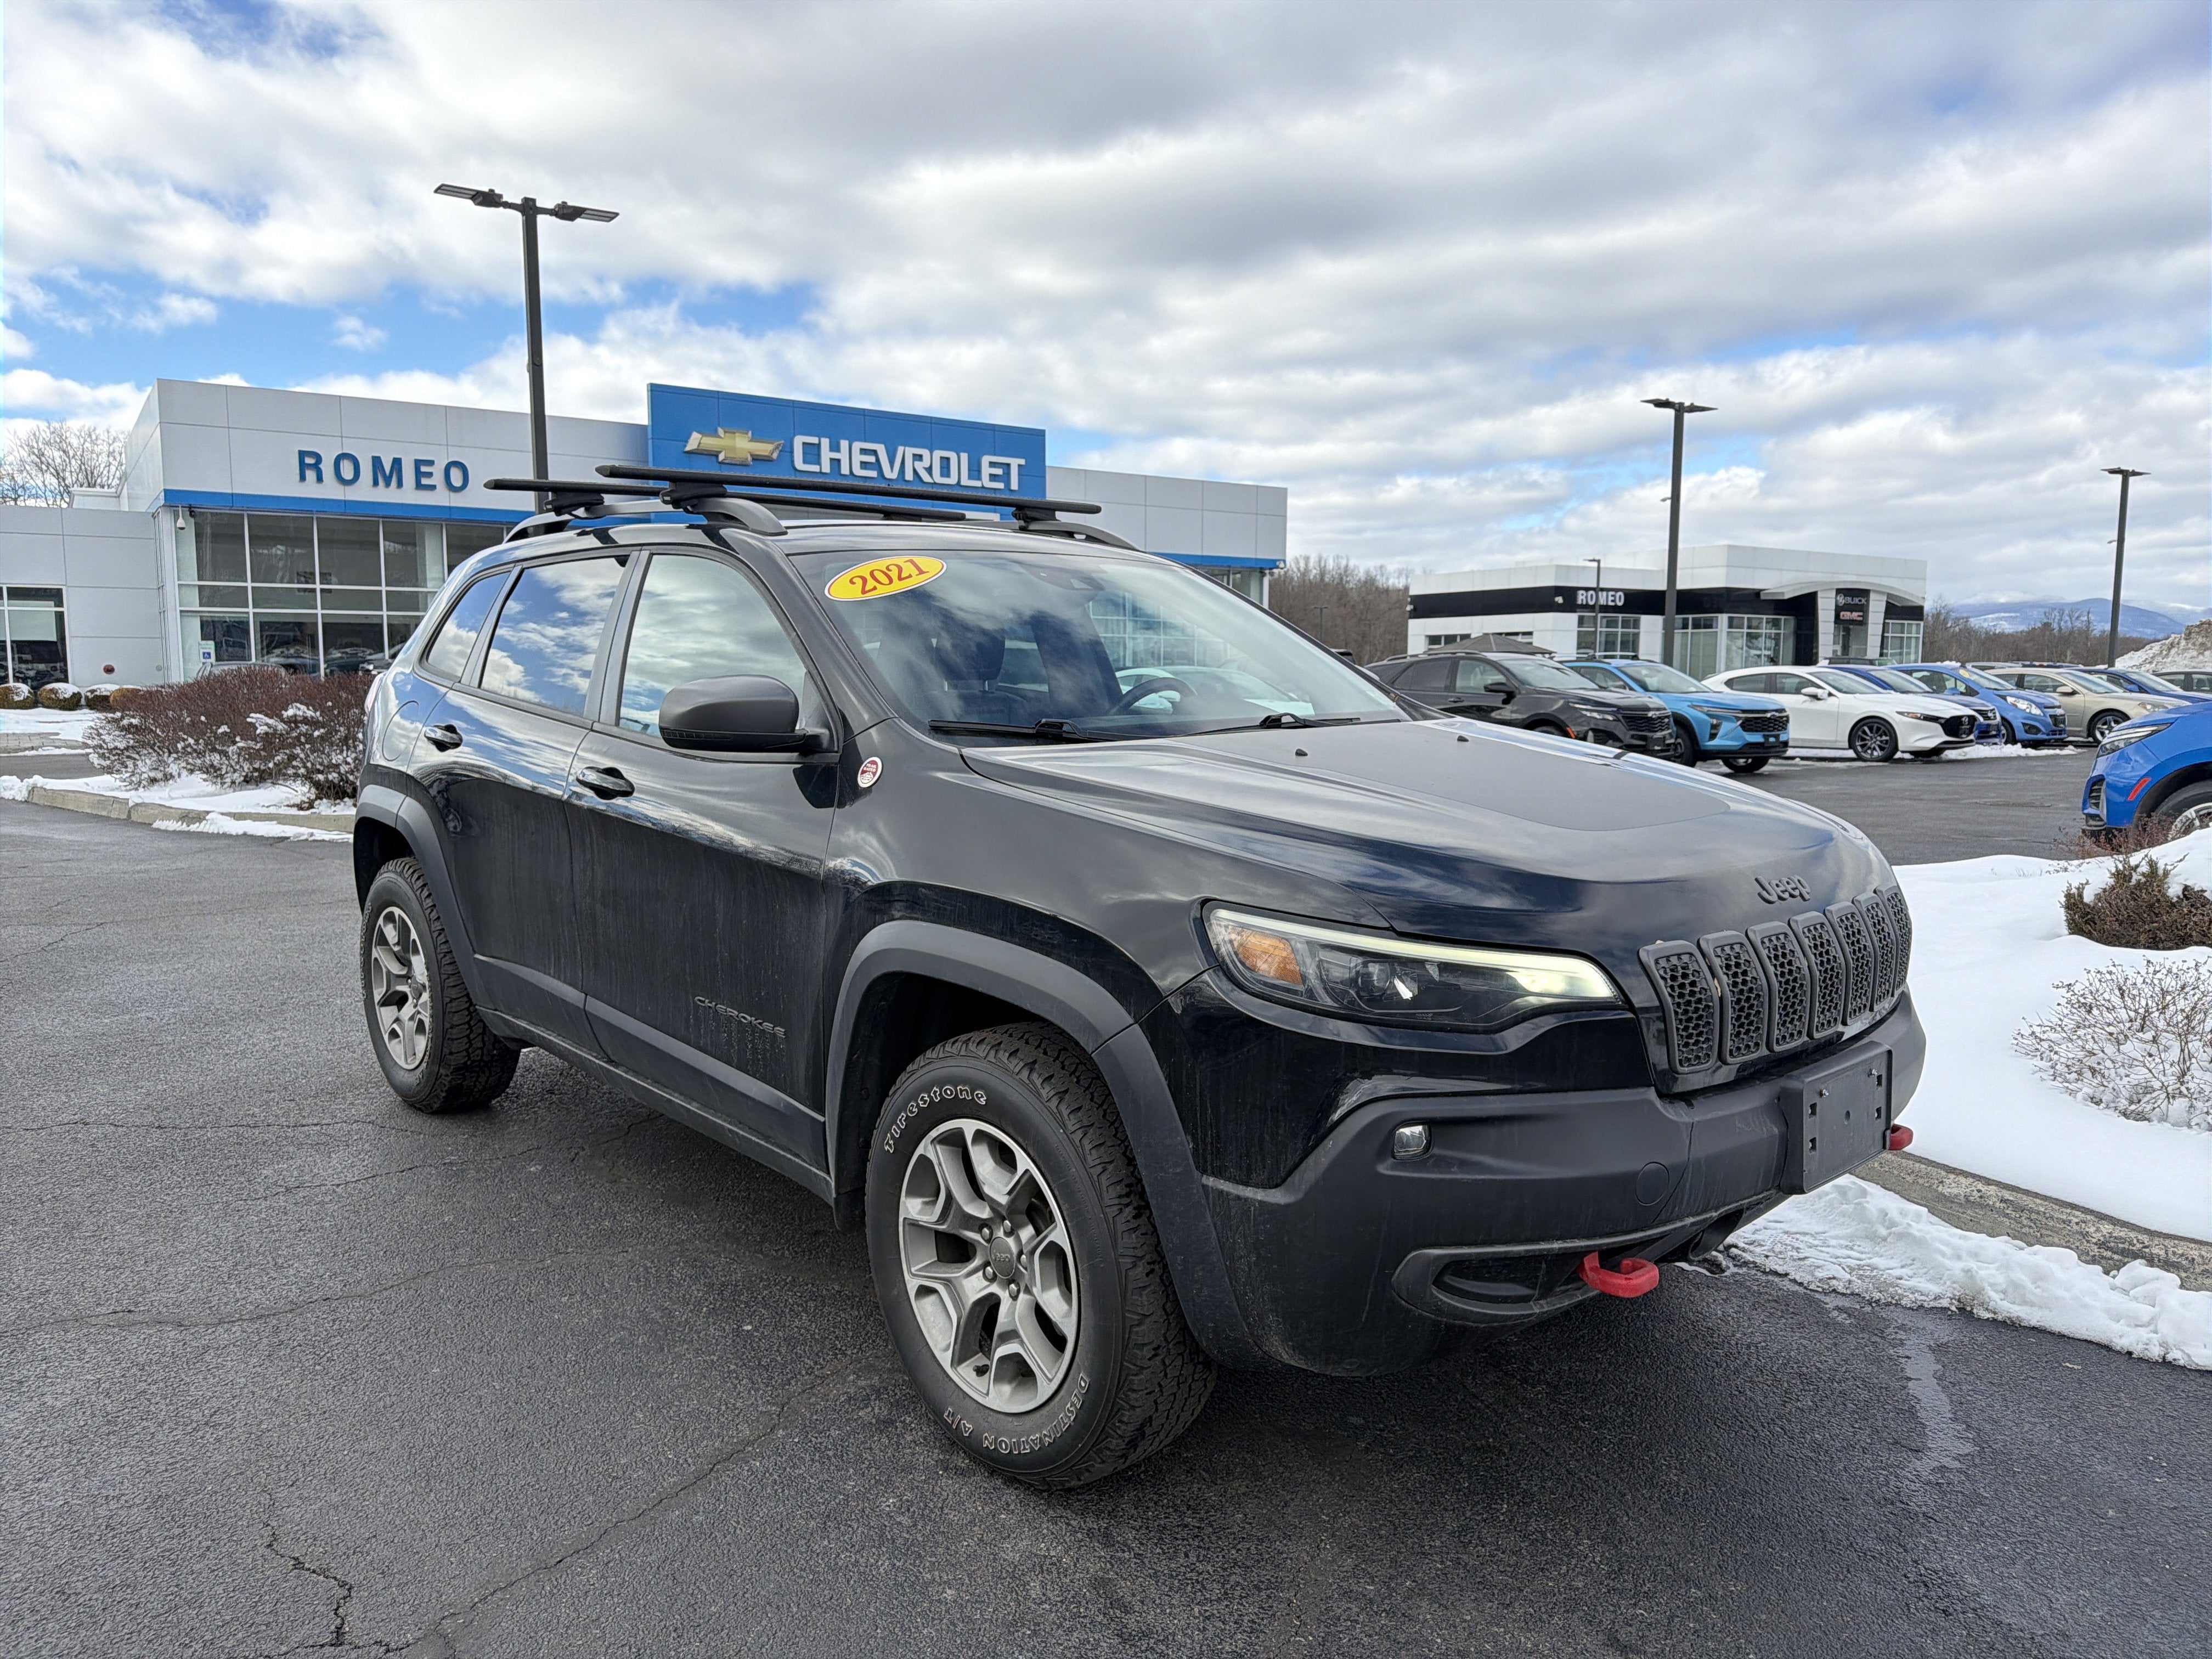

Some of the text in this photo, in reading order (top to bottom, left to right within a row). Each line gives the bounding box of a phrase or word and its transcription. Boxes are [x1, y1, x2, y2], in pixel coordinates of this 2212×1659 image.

[298, 450, 470, 493] ROMEO
[793, 435, 1025, 490] CHEVROLET
[849, 558, 930, 595] 2021
[1577, 590, 1624, 606] ROMEO
[1839, 611, 1863, 620] GMC
[1844, 596, 1867, 605] BUICK
[1754, 875, 1811, 904] Jeep
[694, 996, 786, 1038] CHEROKEE
[884, 1085, 987, 1154] Firestone
[983, 1373, 1090, 1454] DESTINATION
